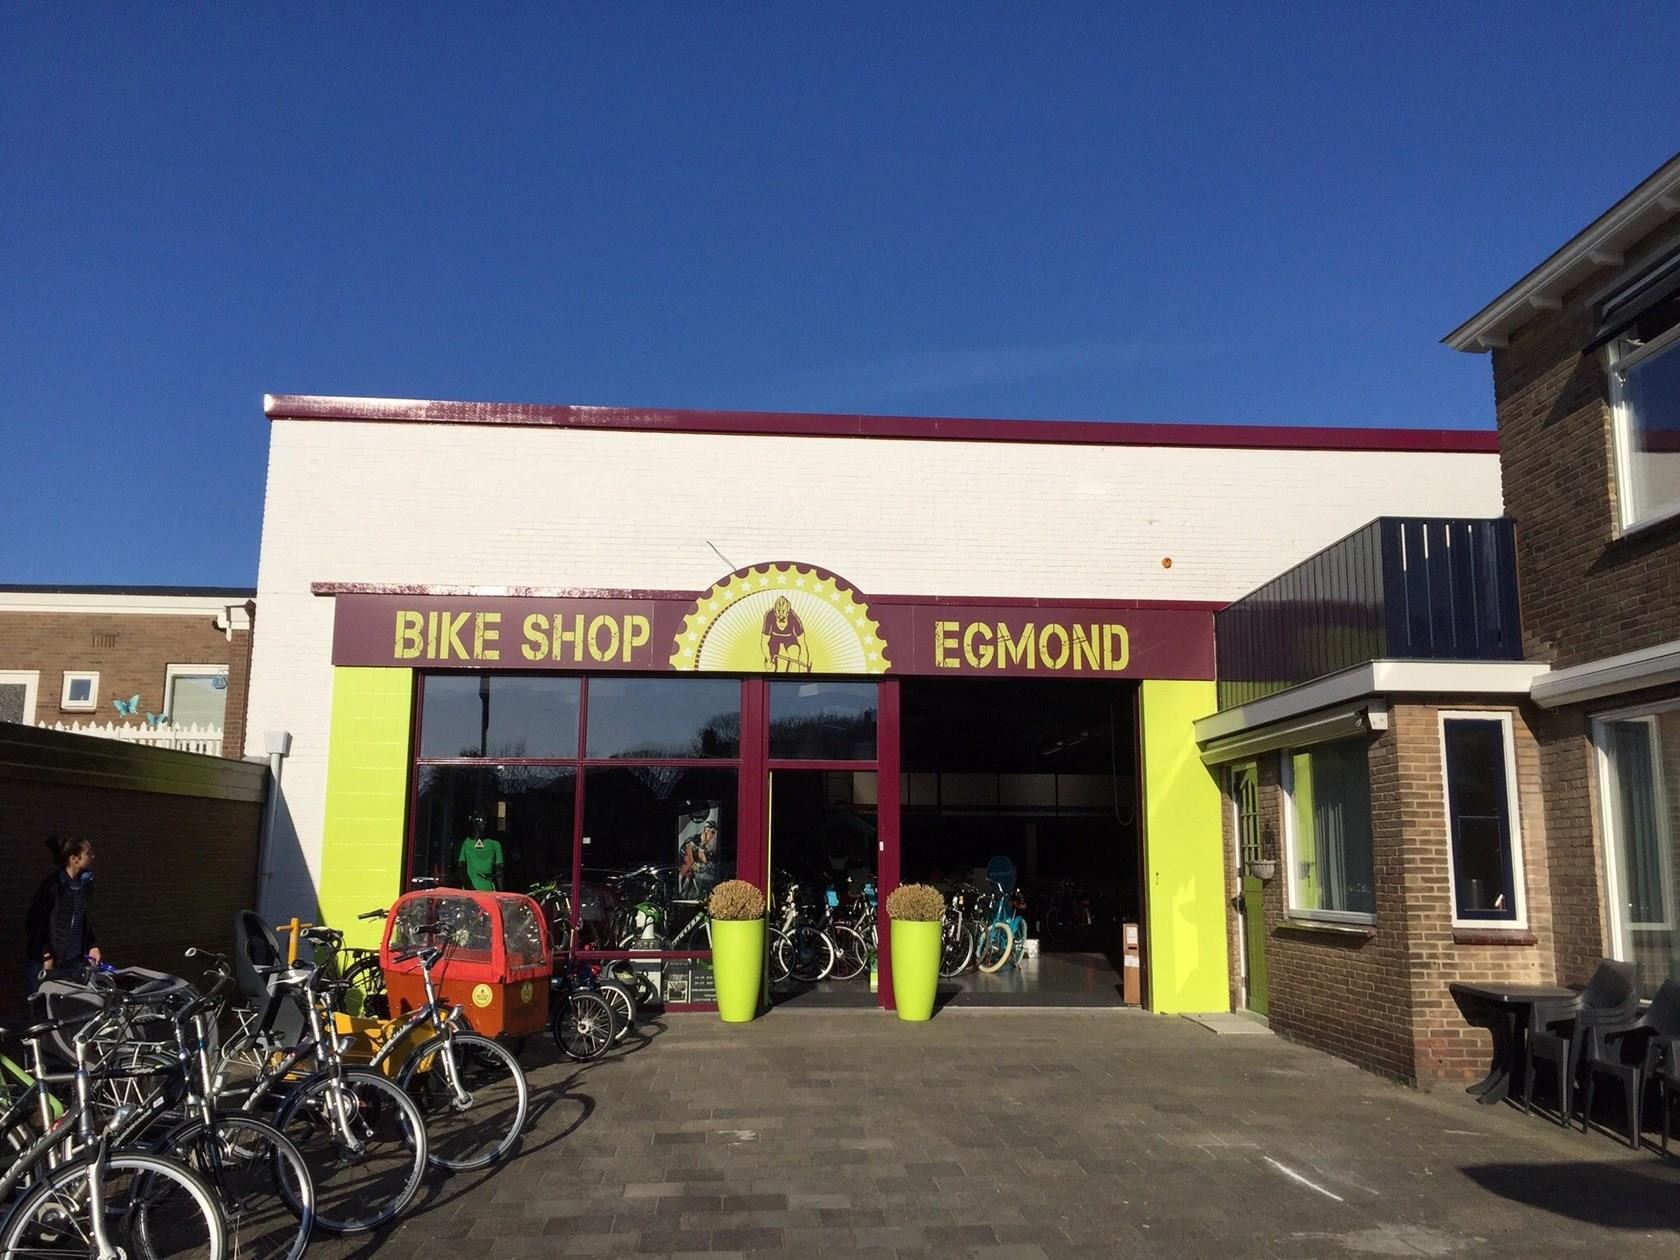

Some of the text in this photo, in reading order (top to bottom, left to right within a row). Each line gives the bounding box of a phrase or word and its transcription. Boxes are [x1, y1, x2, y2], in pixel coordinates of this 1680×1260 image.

[394, 610, 1130, 671] BIKE SHOP EGMOND
